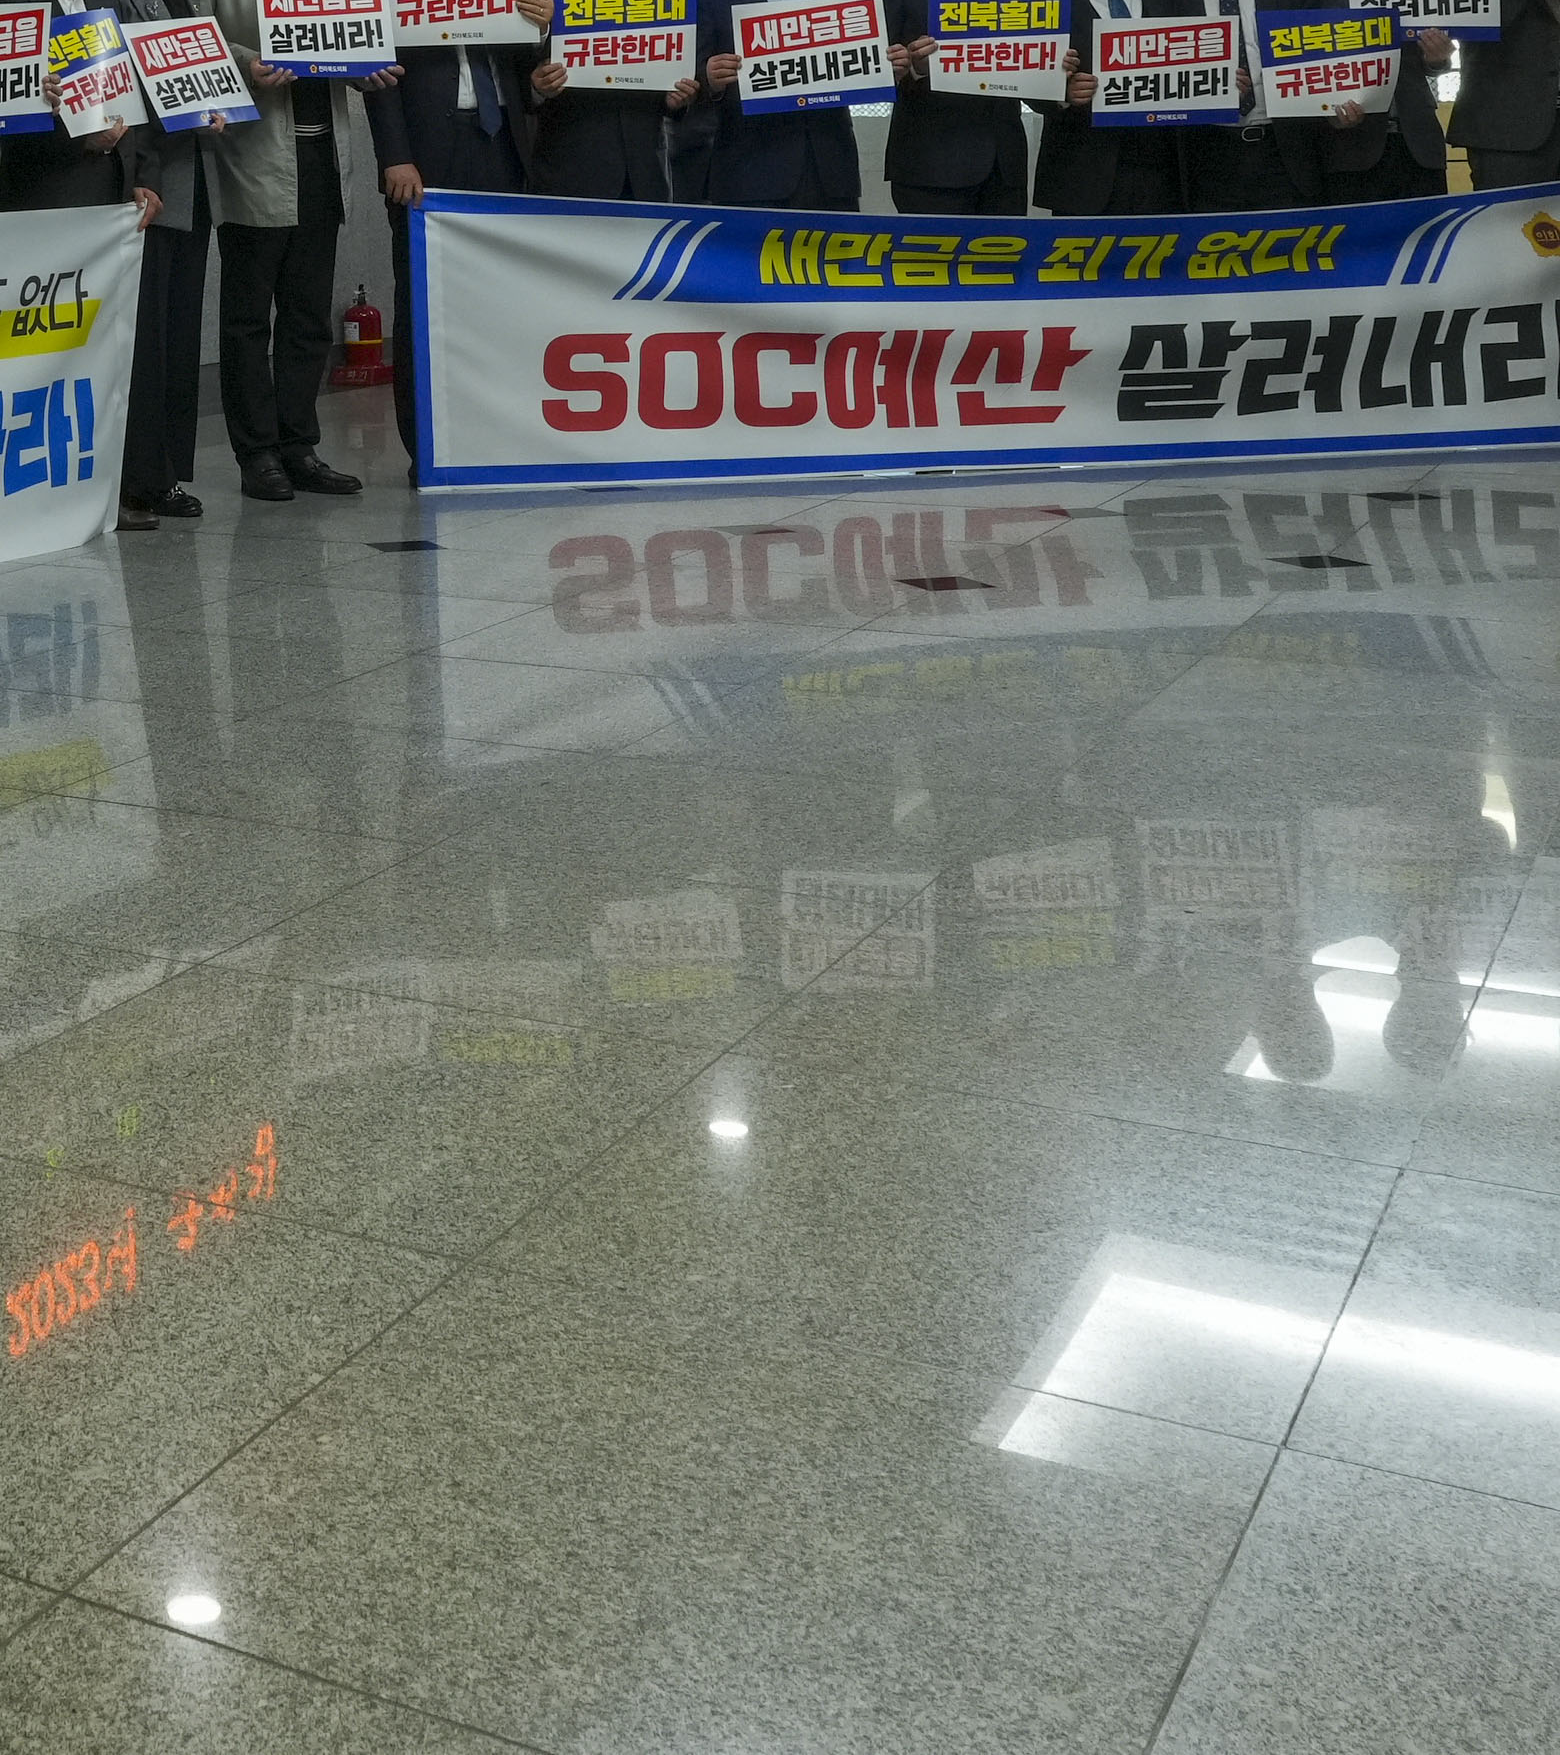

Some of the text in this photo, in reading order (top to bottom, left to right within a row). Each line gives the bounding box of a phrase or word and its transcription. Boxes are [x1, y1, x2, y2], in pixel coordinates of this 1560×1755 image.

[270, 19, 382, 53] 살려내라!
[750, 5, 870, 51] 새만금을
[939, 0, 1060, 33] 전북홀대
[1270, 16, 1392, 58] 전북홀대
[140, 28, 222, 70] 새만금을
[563, 32, 683, 68] 규탄한다!
[940, 42, 1056, 74] 규탄한다!
[1107, 26, 1225, 68] 새만금을
[61, 61, 133, 115] 규탄한다!
[155, 66, 242, 111] 살려내라!
[748, 45, 881, 93] 살려내라!
[1104, 67, 1229, 106] 살려내라!
[1276, 58, 1391, 99] 규탄한다!
[758, 222, 1346, 287] 새만금은 죄가 없다!
[542, 325, 1091, 433] SOC예산
